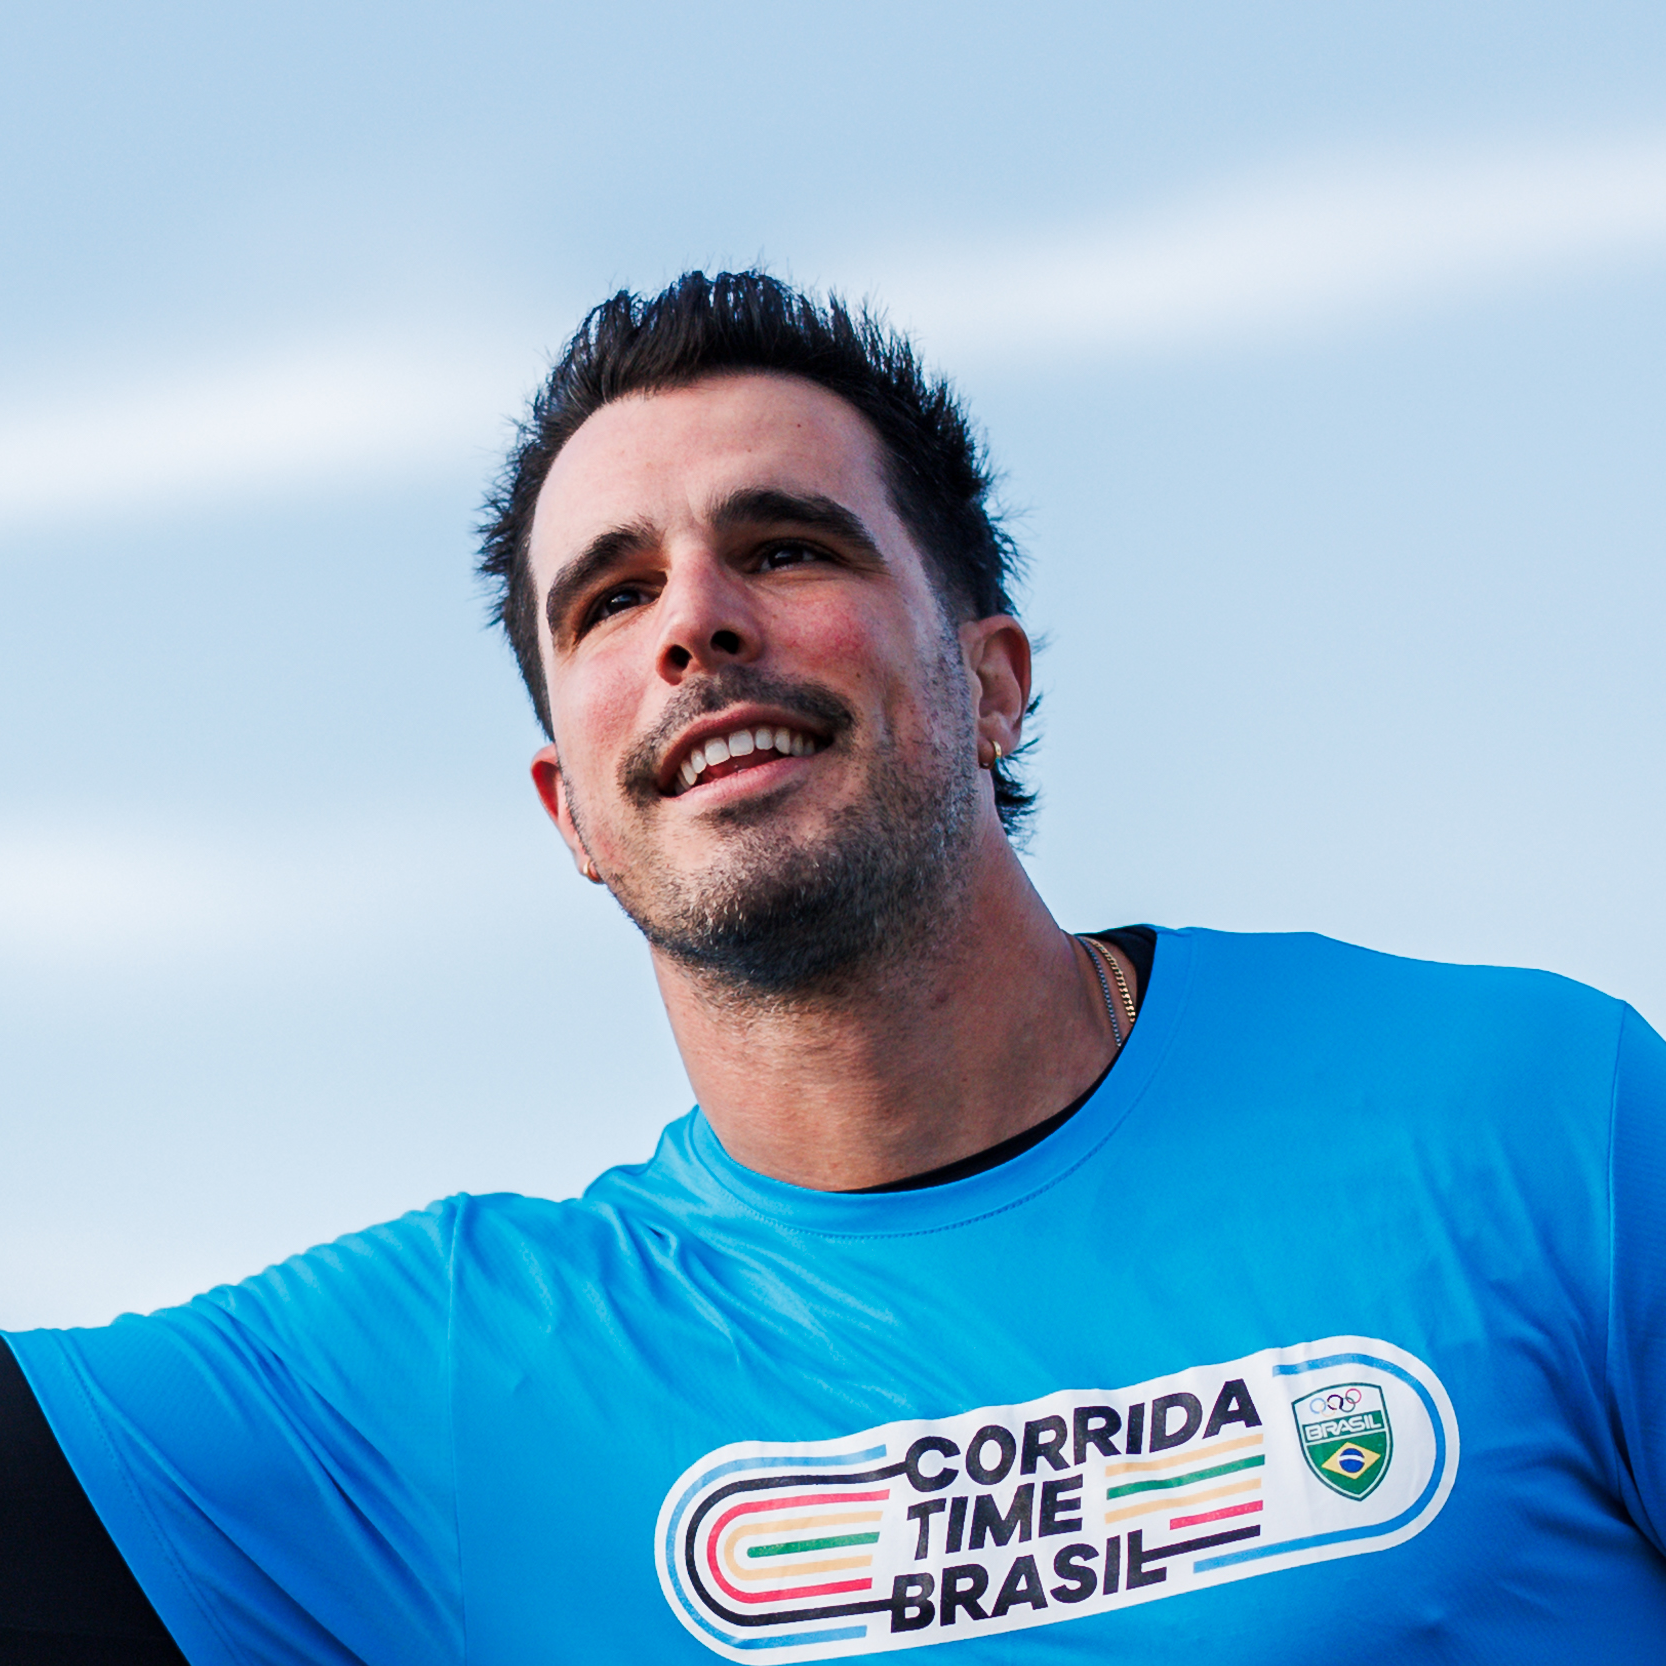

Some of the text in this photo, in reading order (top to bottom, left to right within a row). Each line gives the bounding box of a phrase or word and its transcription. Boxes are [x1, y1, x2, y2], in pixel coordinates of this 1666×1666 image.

[907, 1378, 1262, 1495] CORRIDA
[1305, 1414, 1382, 1441] BRASIL
[907, 1474, 1086, 1560] TIME
[890, 1529, 1168, 1634] BRASIL
